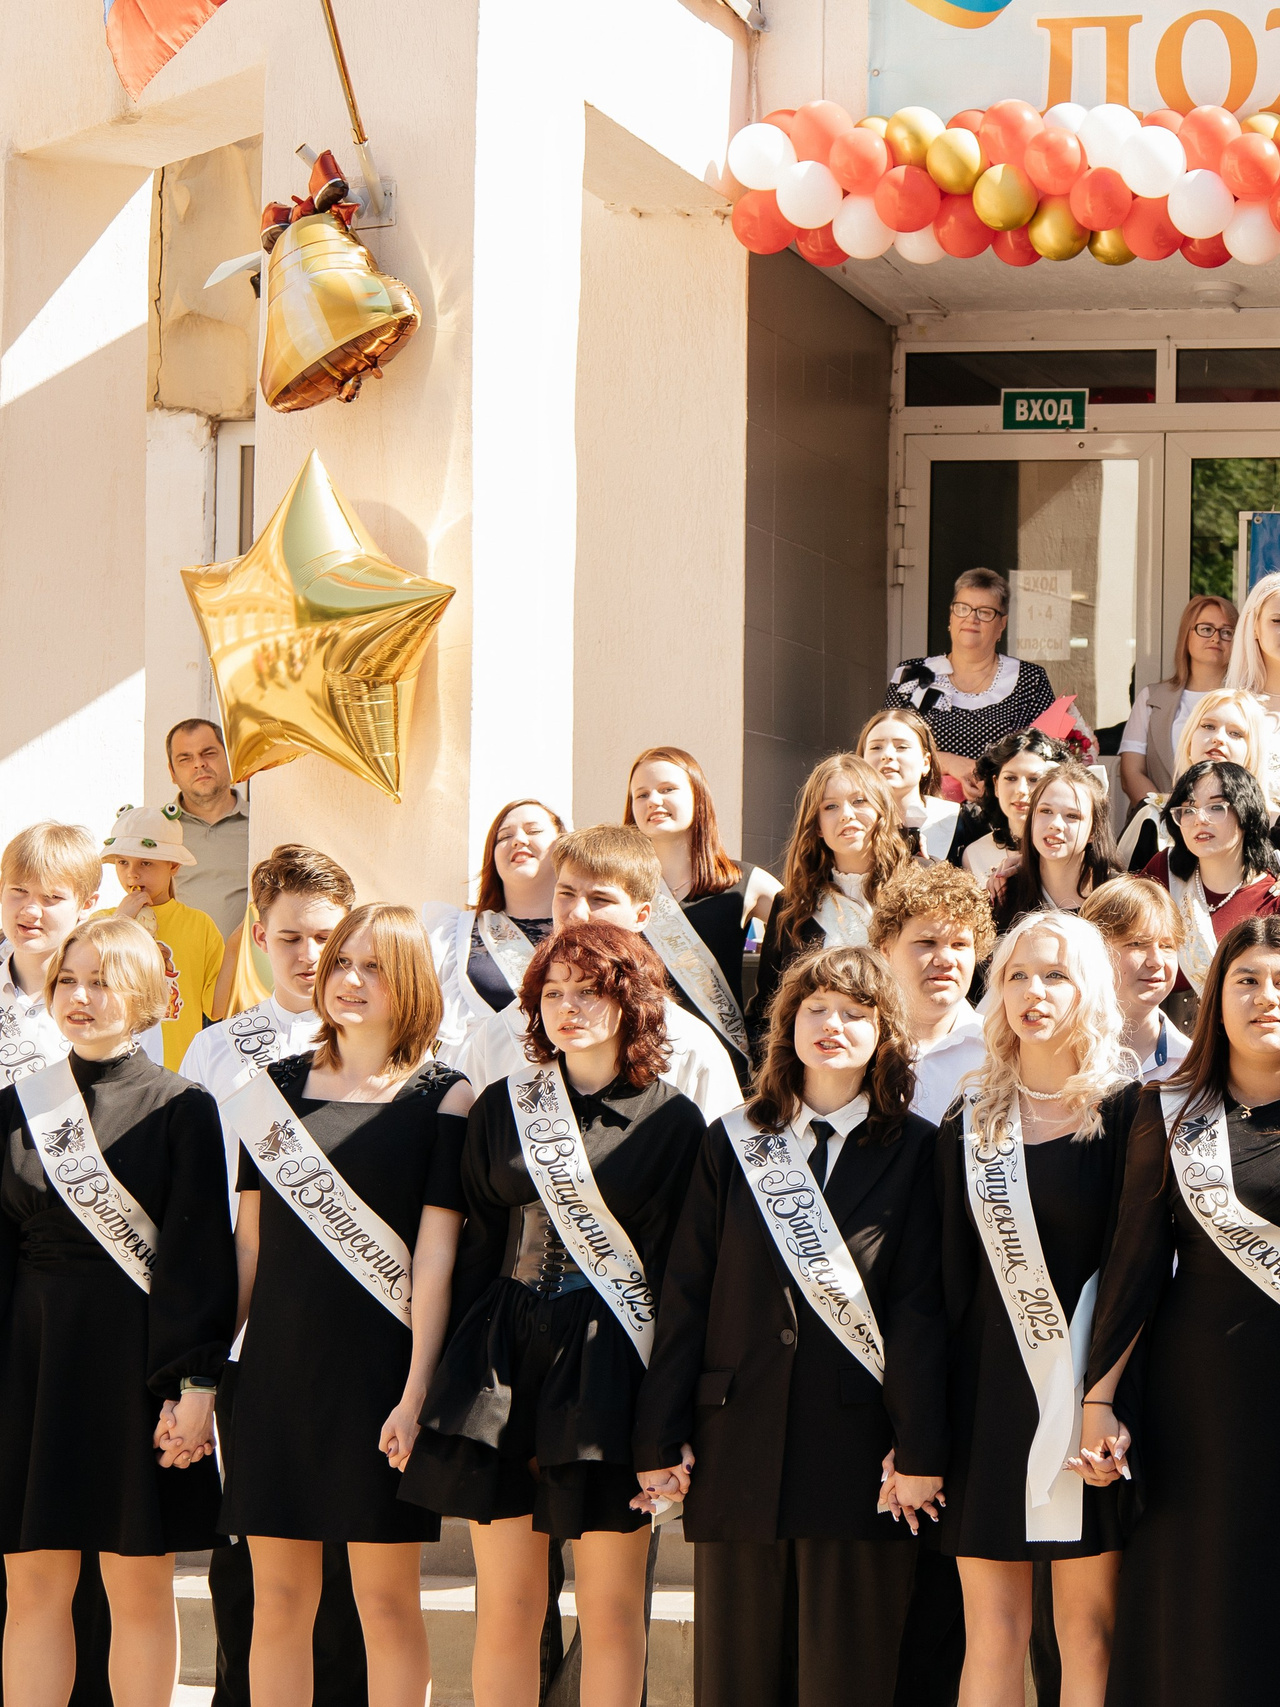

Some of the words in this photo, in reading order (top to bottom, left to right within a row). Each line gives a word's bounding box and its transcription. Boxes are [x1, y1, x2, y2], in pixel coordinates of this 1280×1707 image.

[1015, 399, 1074, 425] ВХОД
[1023, 576, 1058, 593] ВХОД
[1017, 638, 1063, 650] классы
[525, 1118, 617, 1277] Выпускник
[276, 1156, 409, 1301] Выпускник
[1017, 1287, 1064, 1342] 2025
